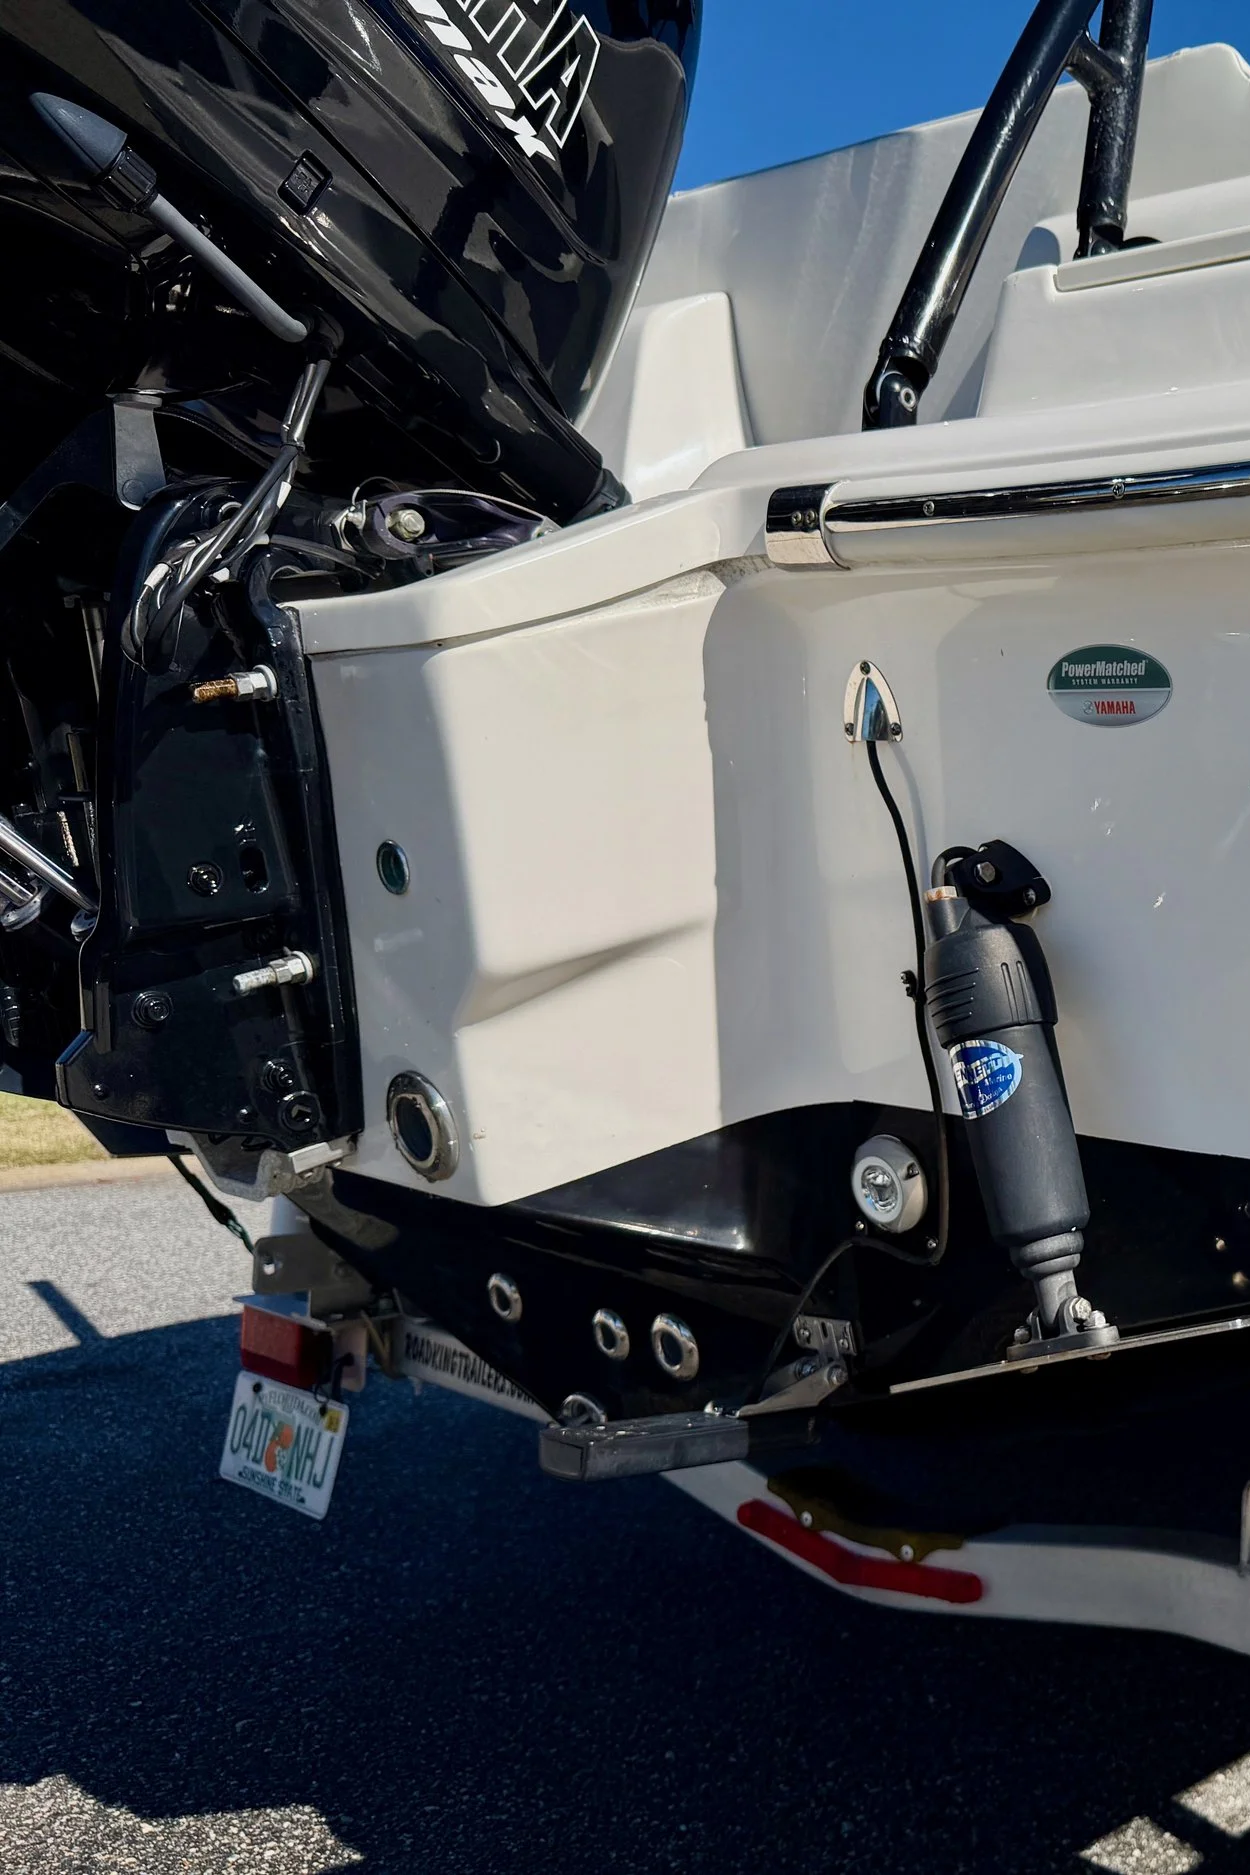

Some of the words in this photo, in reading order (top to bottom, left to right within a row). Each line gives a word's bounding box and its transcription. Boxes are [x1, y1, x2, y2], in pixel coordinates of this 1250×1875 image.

[1061, 660, 1147, 677] PowerMatched
[1101, 677, 1138, 685] WARRANTY
[1094, 700, 1136, 715] YAMAHA
[287, 1422, 335, 1490] NHJ
[242, 1465, 277, 1491] SUNSHINE
[278, 1480, 303, 1500] STATE
